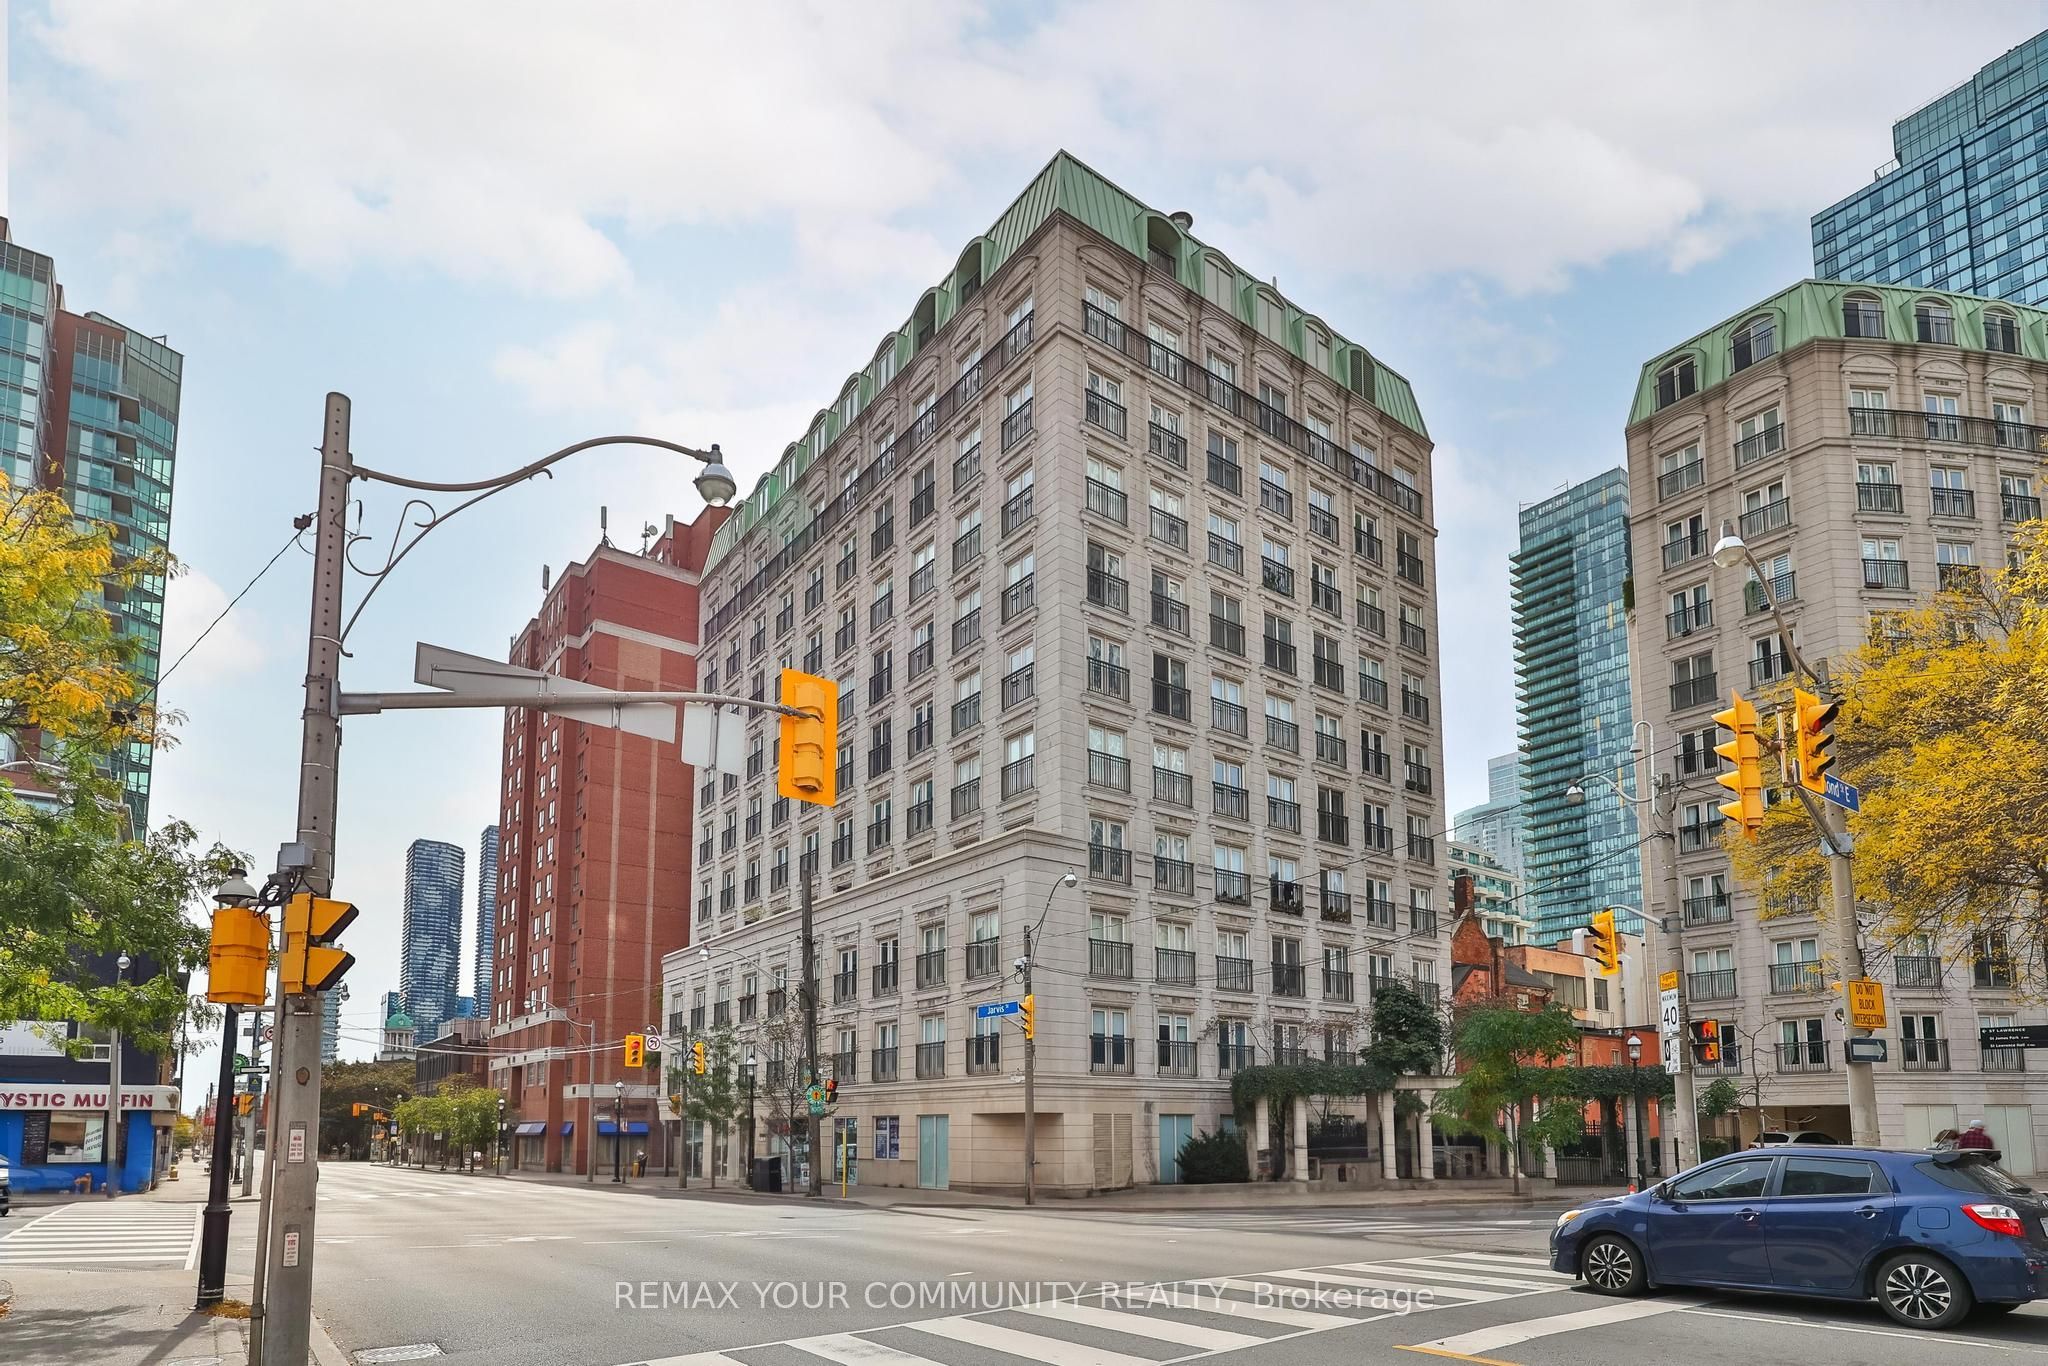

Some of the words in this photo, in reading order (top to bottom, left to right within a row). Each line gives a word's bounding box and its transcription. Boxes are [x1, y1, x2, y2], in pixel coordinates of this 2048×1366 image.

[1826, 781, 1840, 798] ond
[1845, 786, 1851, 803] E
[1855, 983, 1863, 995] DO
[1865, 984, 1876, 996] NOT
[1662, 993, 1677, 1001] MAXIMUM
[987, 1005, 1005, 1015] Jarvis
[1858, 998, 1876, 1010] BLOCK
[1664, 1006, 1677, 1026] 40
[1854, 1013, 1885, 1025] INTERSECTION
[0, 1093, 66, 1107] YSTIC
[73, 1093, 154, 1108] MUFIN
